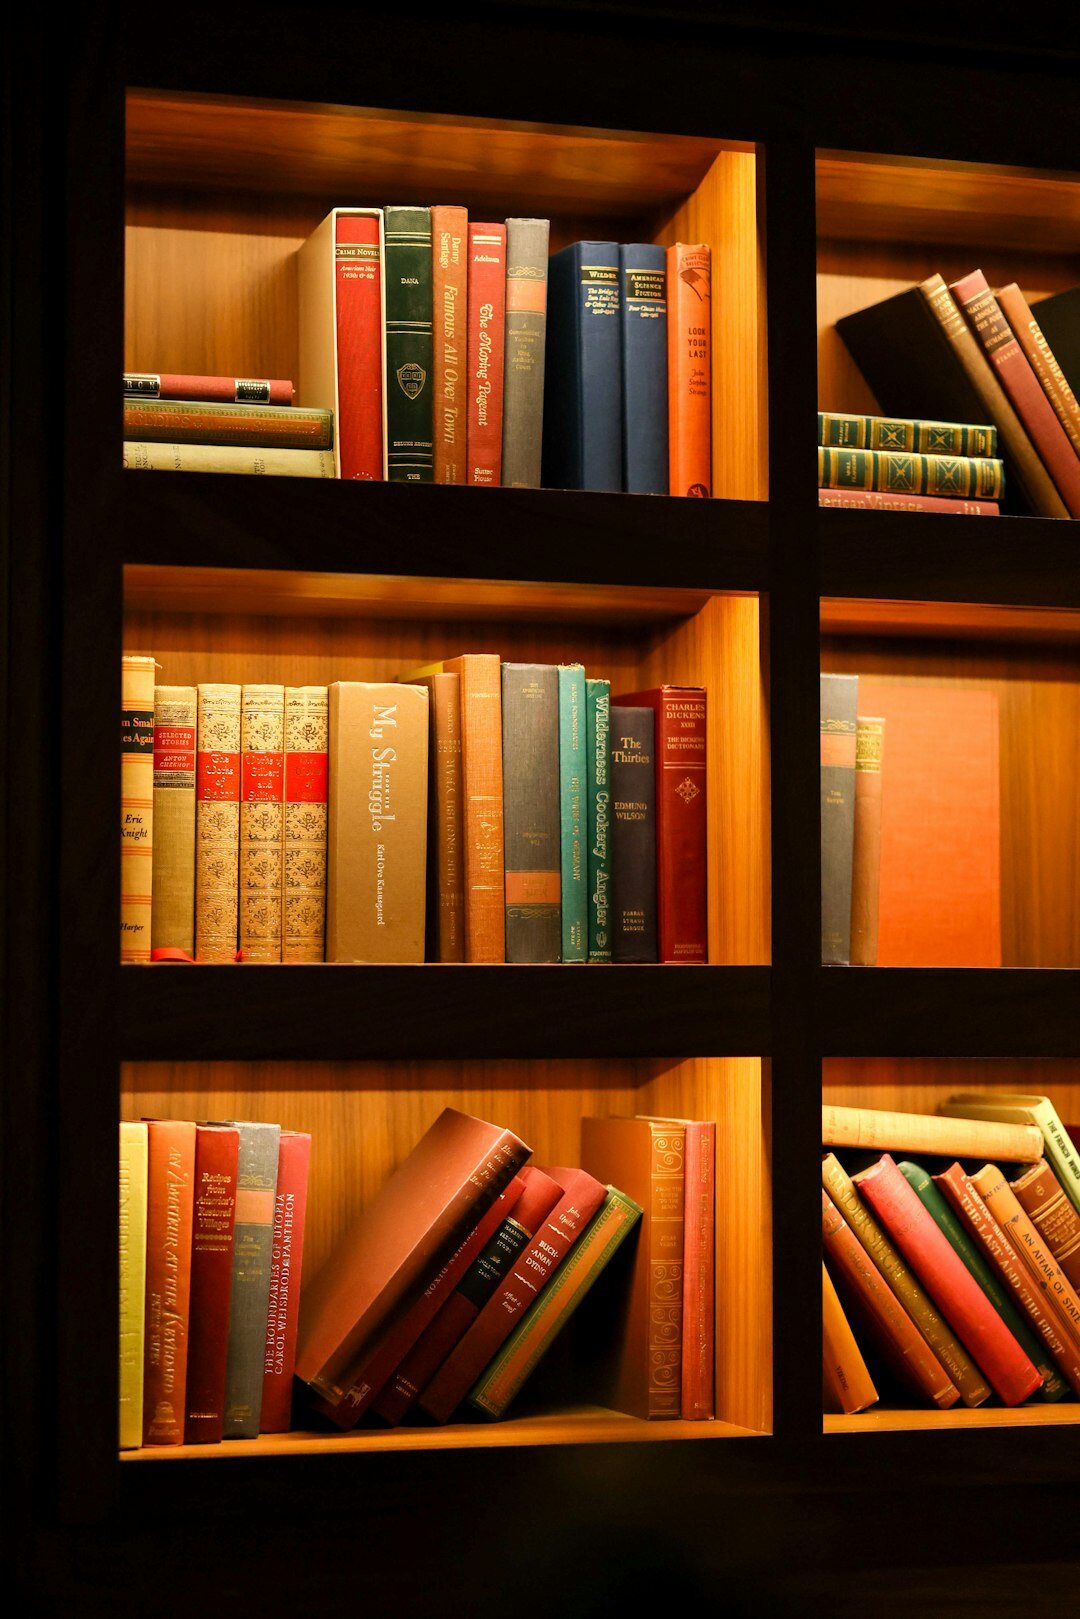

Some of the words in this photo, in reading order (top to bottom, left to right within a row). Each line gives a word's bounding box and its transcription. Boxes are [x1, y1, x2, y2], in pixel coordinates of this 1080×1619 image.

[439, 232, 450, 269] Santiago
[451, 237, 461, 265] Danny
[589, 271, 617, 279] WILDER
[631, 274, 664, 282] AMERICAN
[634, 289, 662, 297] FICTION
[444, 284, 458, 338] Famous
[479, 303, 493, 328] The
[687, 339, 707, 347] YOUR
[688, 327, 706, 335] LOOK
[444, 343, 458, 365] All
[476, 331, 492, 379] Moving
[688, 350, 707, 358] LAST
[443, 369, 459, 402] Over
[476, 381, 491, 426] Pageant
[444, 407, 458, 444] Town
[666, 703, 705, 711] CHARLES
[666, 711, 705, 720] DICKENS
[133, 717, 154, 727] Small
[369, 704, 398, 739] My
[595, 693, 610, 785] Wilderness
[620, 737, 641, 749] The
[612, 751, 650, 763] Thirties
[446, 759, 456, 793] YEAR
[368, 747, 397, 832] Struggle
[614, 802, 648, 810] EDMUND
[616, 811, 646, 820] WILSON
[124, 814, 143, 824] Eric
[592, 790, 610, 861] Cookery
[120, 827, 148, 840] Knight
[377, 844, 385, 861] Karl
[377, 862, 385, 878] Ove
[375, 879, 385, 926] Knausgaard
[592, 870, 608, 926] Angier
[1047, 1120, 1058, 1134] THE
[1054, 1134, 1071, 1159] FRENCH
[201, 1172, 232, 1185] Recipes
[205, 1184, 226, 1196] from
[827, 1165, 872, 1234] UNDER
[273, 1193, 285, 1240] UTOPIA
[566, 1206, 581, 1218] John
[282, 1193, 295, 1261] PANTHEON
[271, 1243, 281, 1259] OF
[525, 1257, 547, 1276] DYING
[960, 1193, 978, 1226] THE
[977, 1224, 1003, 1258] LAST
[1000, 1258, 1021, 1290] AND
[1020, 1288, 1041, 1319] THE
[1038, 1317, 1065, 1354] FIRST
[1022, 1232, 1035, 1247] AN
[1033, 1250, 1055, 1280] AFFAIR
[1053, 1281, 1065, 1295] OF
[1062, 1297, 1080, 1323] STATE
[266, 1263, 280, 1345] BOUNDARIES
[277, 1264, 290, 1331] WEISBROD
[264, 1350, 275, 1374] THE
[274, 1333, 286, 1375] CAROL
